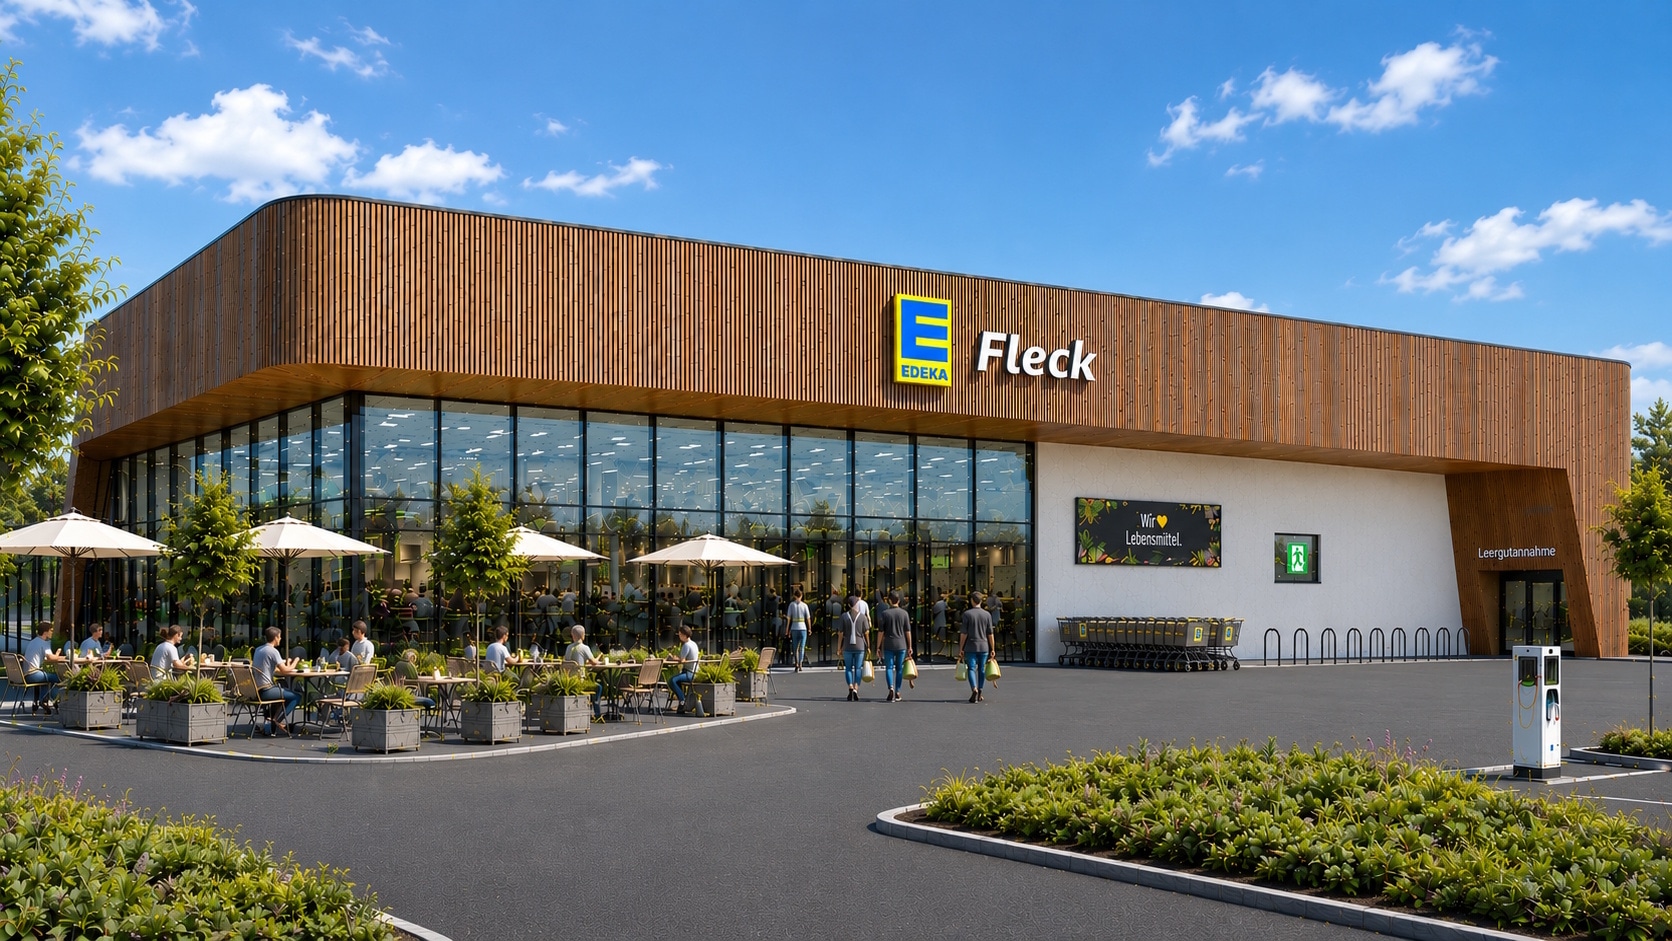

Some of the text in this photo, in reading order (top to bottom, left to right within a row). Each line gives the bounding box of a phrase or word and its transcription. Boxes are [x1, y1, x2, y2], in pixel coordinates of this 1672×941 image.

[901, 299, 948, 362] E
[977, 331, 1097, 381] Fleck
[901, 365, 948, 381] EDEKA
[1140, 513, 1156, 528] Wir
[1478, 545, 1556, 561] Leergutannahme
